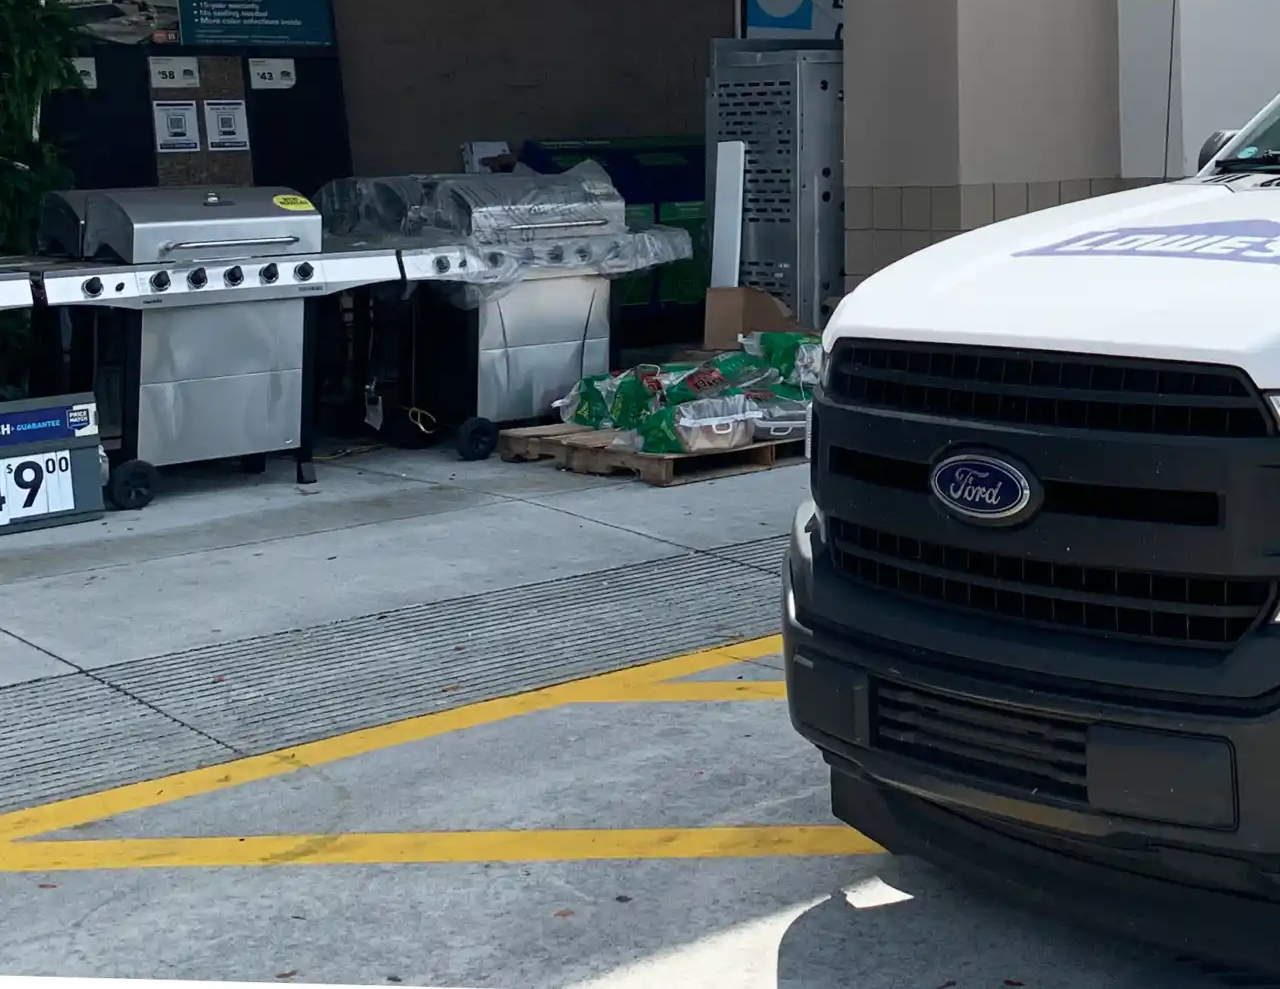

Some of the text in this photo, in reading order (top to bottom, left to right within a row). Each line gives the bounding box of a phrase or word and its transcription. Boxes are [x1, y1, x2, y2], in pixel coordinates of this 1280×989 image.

[69, 410, 87, 418] PRICE
[16, 419, 61, 432] GUARANTEE
[950, 467, 1003, 505] Ford
